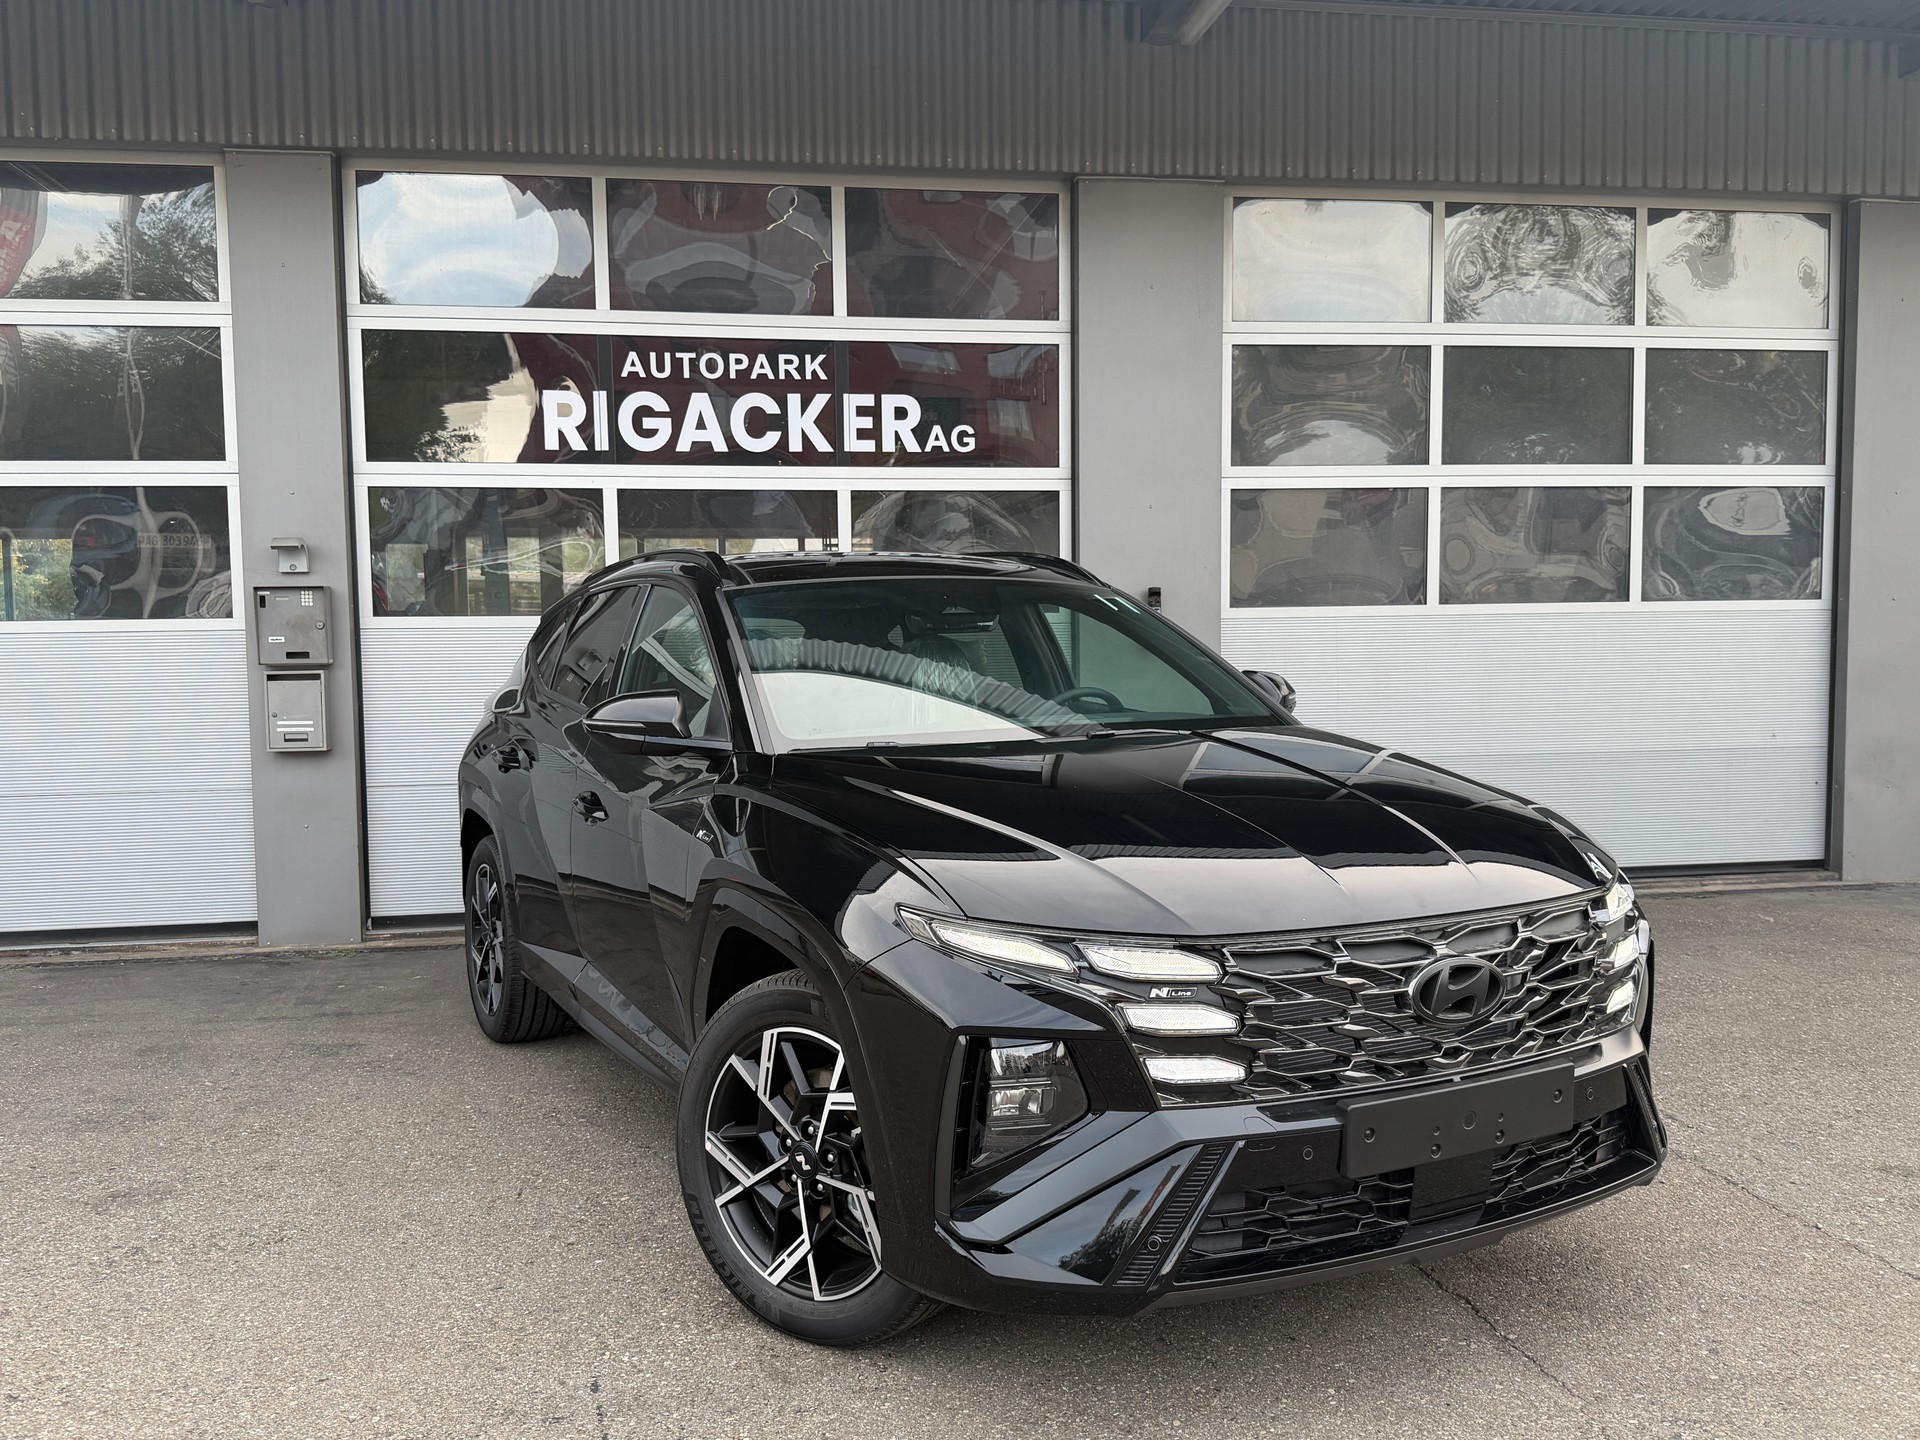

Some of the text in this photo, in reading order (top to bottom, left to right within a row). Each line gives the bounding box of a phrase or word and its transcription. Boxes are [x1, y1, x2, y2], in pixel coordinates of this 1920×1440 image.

[621, 351, 828, 380] AUTOPARK
[542, 389, 976, 453] RIGACKER AG
[162, 535, 204, 547] 30394
[1149, 987, 1170, 998] N
[688, 1199, 754, 1302] MICHELIN
